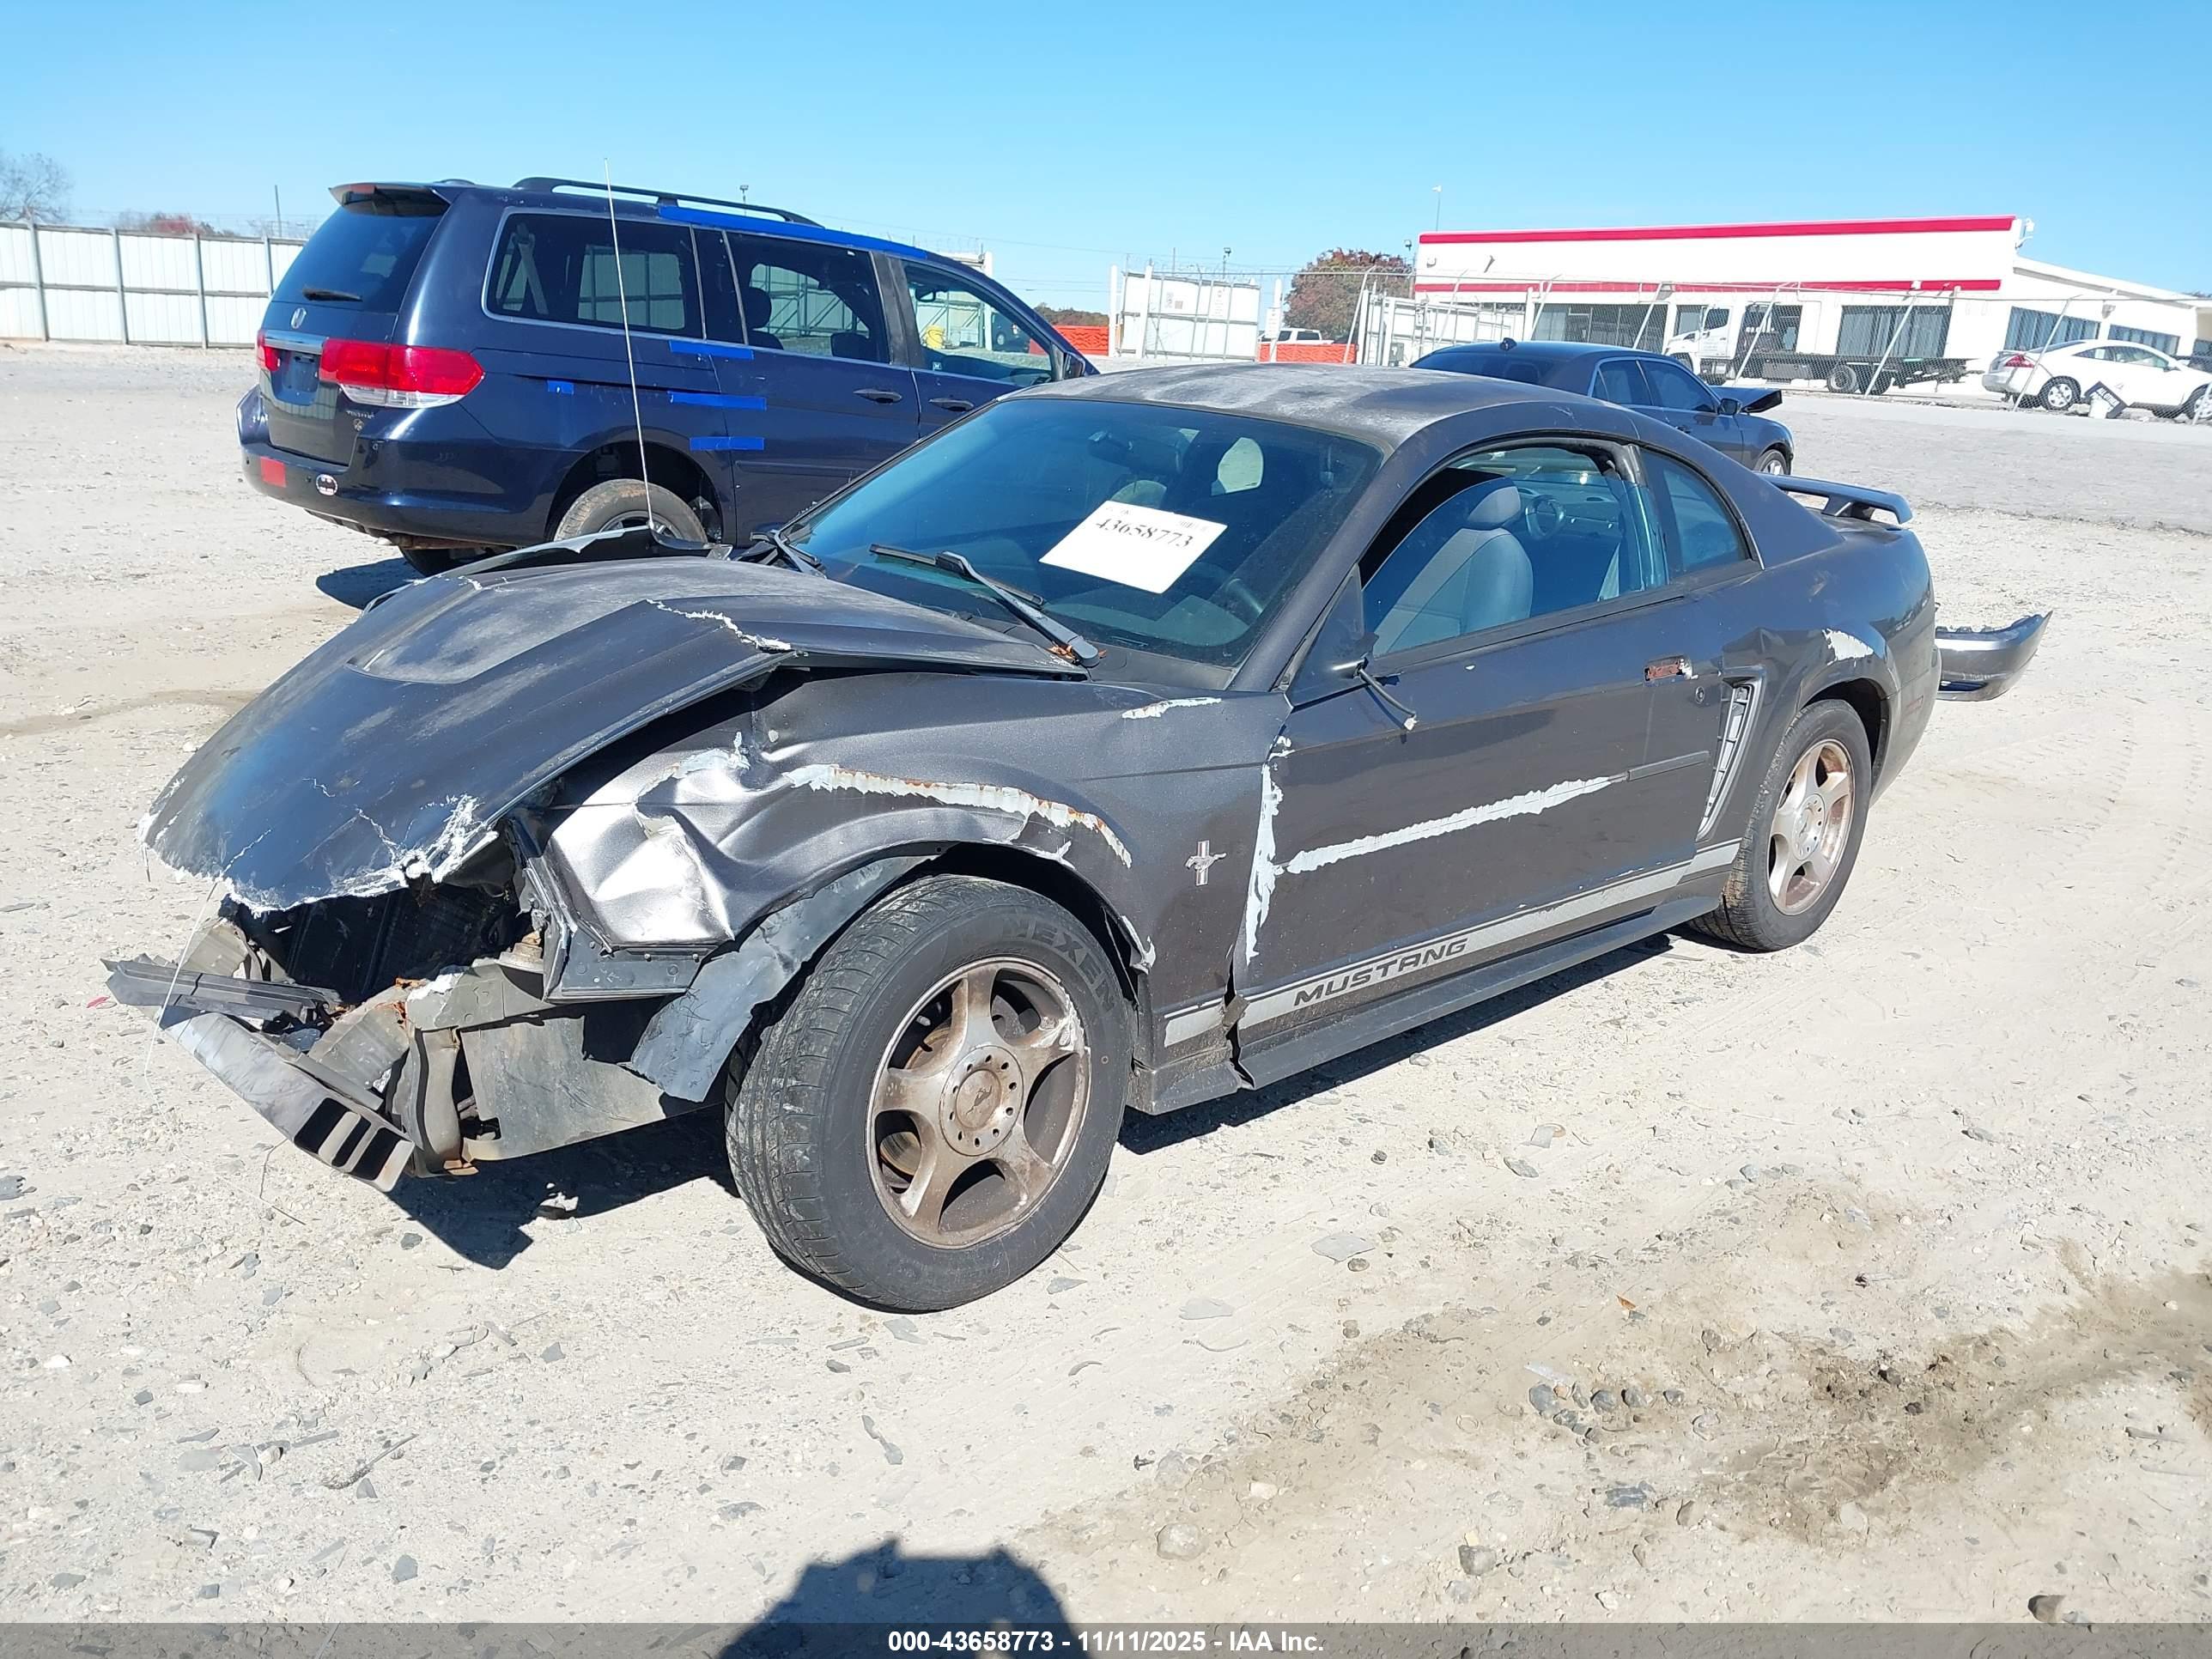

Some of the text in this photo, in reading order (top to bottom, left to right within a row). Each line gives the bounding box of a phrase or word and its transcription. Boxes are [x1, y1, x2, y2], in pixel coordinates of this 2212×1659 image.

[1096, 518, 1194, 547] 43658773
[1001, 917, 1115, 1014] NEXEN
[1293, 937, 1469, 1006] MUSTANG
